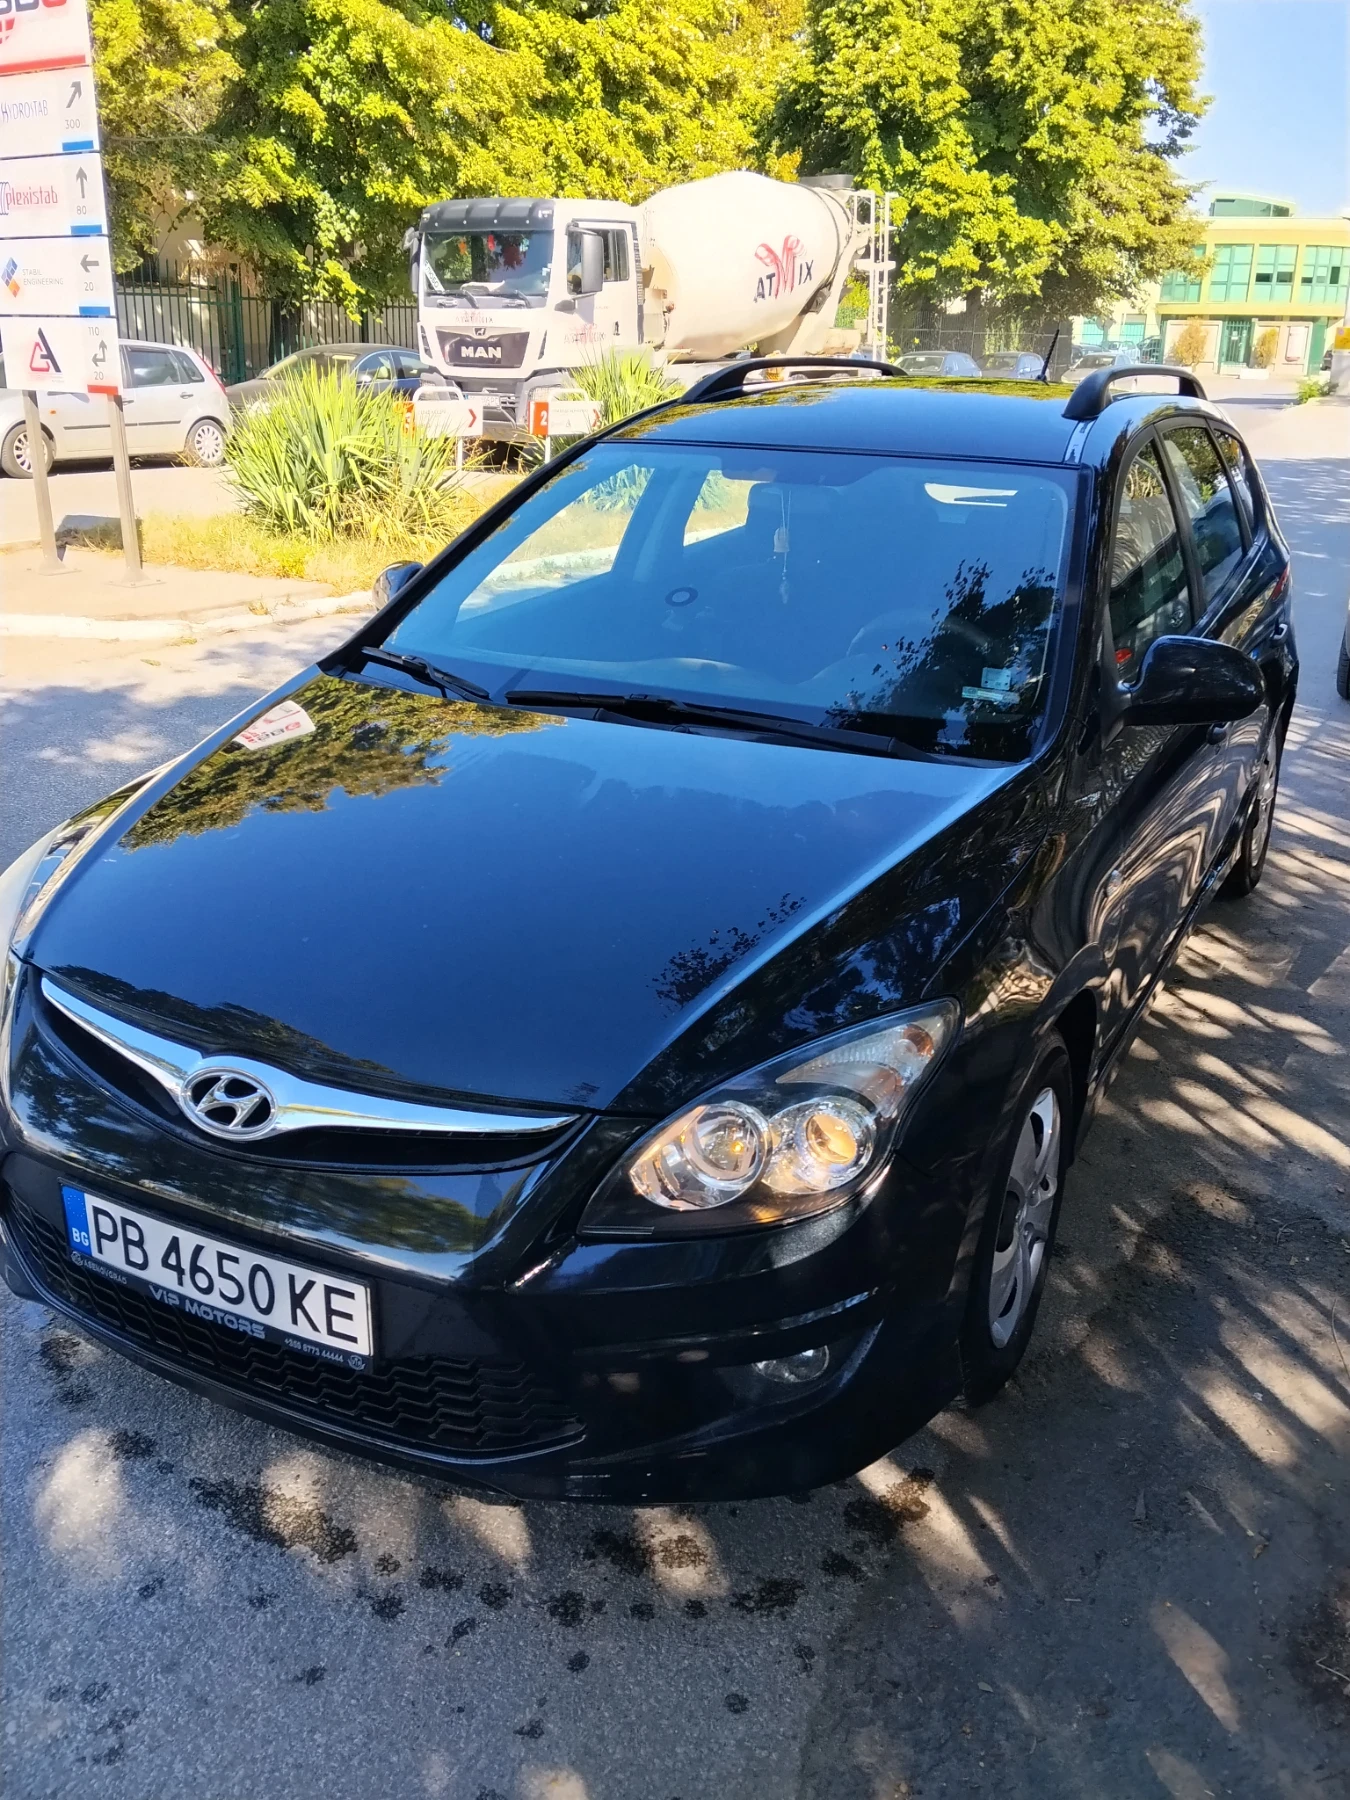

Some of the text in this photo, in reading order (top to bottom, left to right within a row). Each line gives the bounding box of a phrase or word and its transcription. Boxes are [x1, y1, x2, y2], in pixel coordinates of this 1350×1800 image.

[65, 119, 81, 129] 300
[6, 185, 59, 210] plexistab
[76, 205, 87, 215] 80
[23, 278, 64, 286] ENGINEERING
[84, 282, 94, 291] 20
[88, 327, 100, 336] 110
[461, 346, 502, 360] MAN
[94, 371, 104, 380] 20
[540, 410, 548, 426] 2
[72, 1227, 89, 1247] BG
[91, 1205, 358, 1344] PB 4650 KE
[148, 1284, 266, 1340] VIP MOTORS
